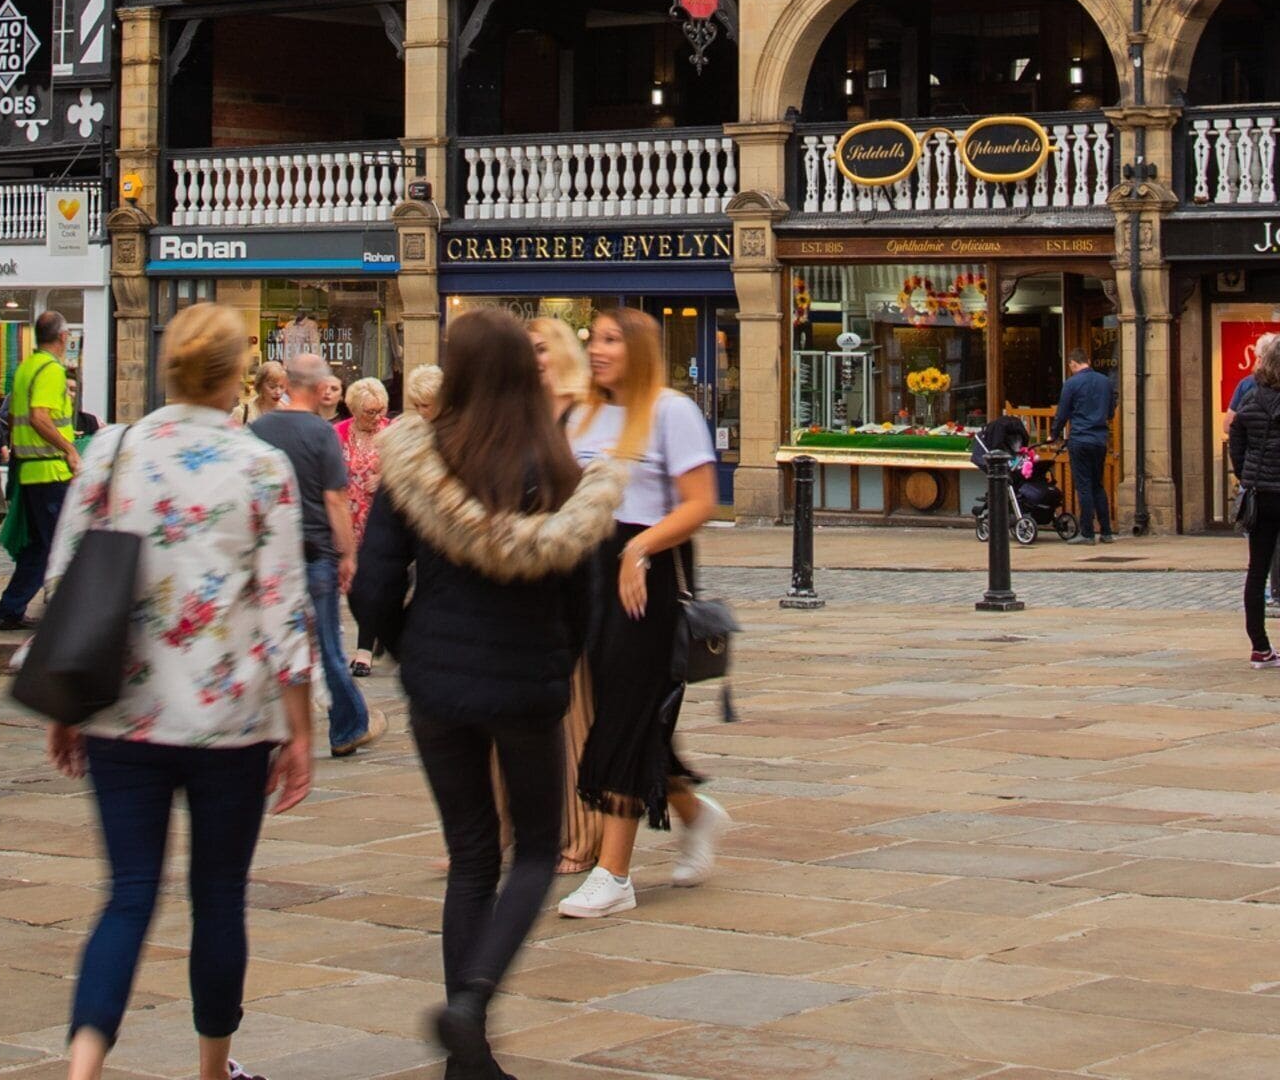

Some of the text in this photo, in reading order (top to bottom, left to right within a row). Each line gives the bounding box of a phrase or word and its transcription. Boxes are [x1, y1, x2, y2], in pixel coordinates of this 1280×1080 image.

[846, 142, 904, 161] Siddalls
[967, 137, 1041, 160] Optometrists
[159, 235, 247, 260] Rohan
[447, 233, 732, 260] CRABTREE & EVELYN
[825, 241, 844, 254] 1815
[887, 239, 945, 255] Ophthalmic
[951, 238, 1001, 254] Opticians
[1072, 239, 1093, 252] 1815
[363, 252, 396, 263] Rohan
[336, 328, 353, 341] THE
